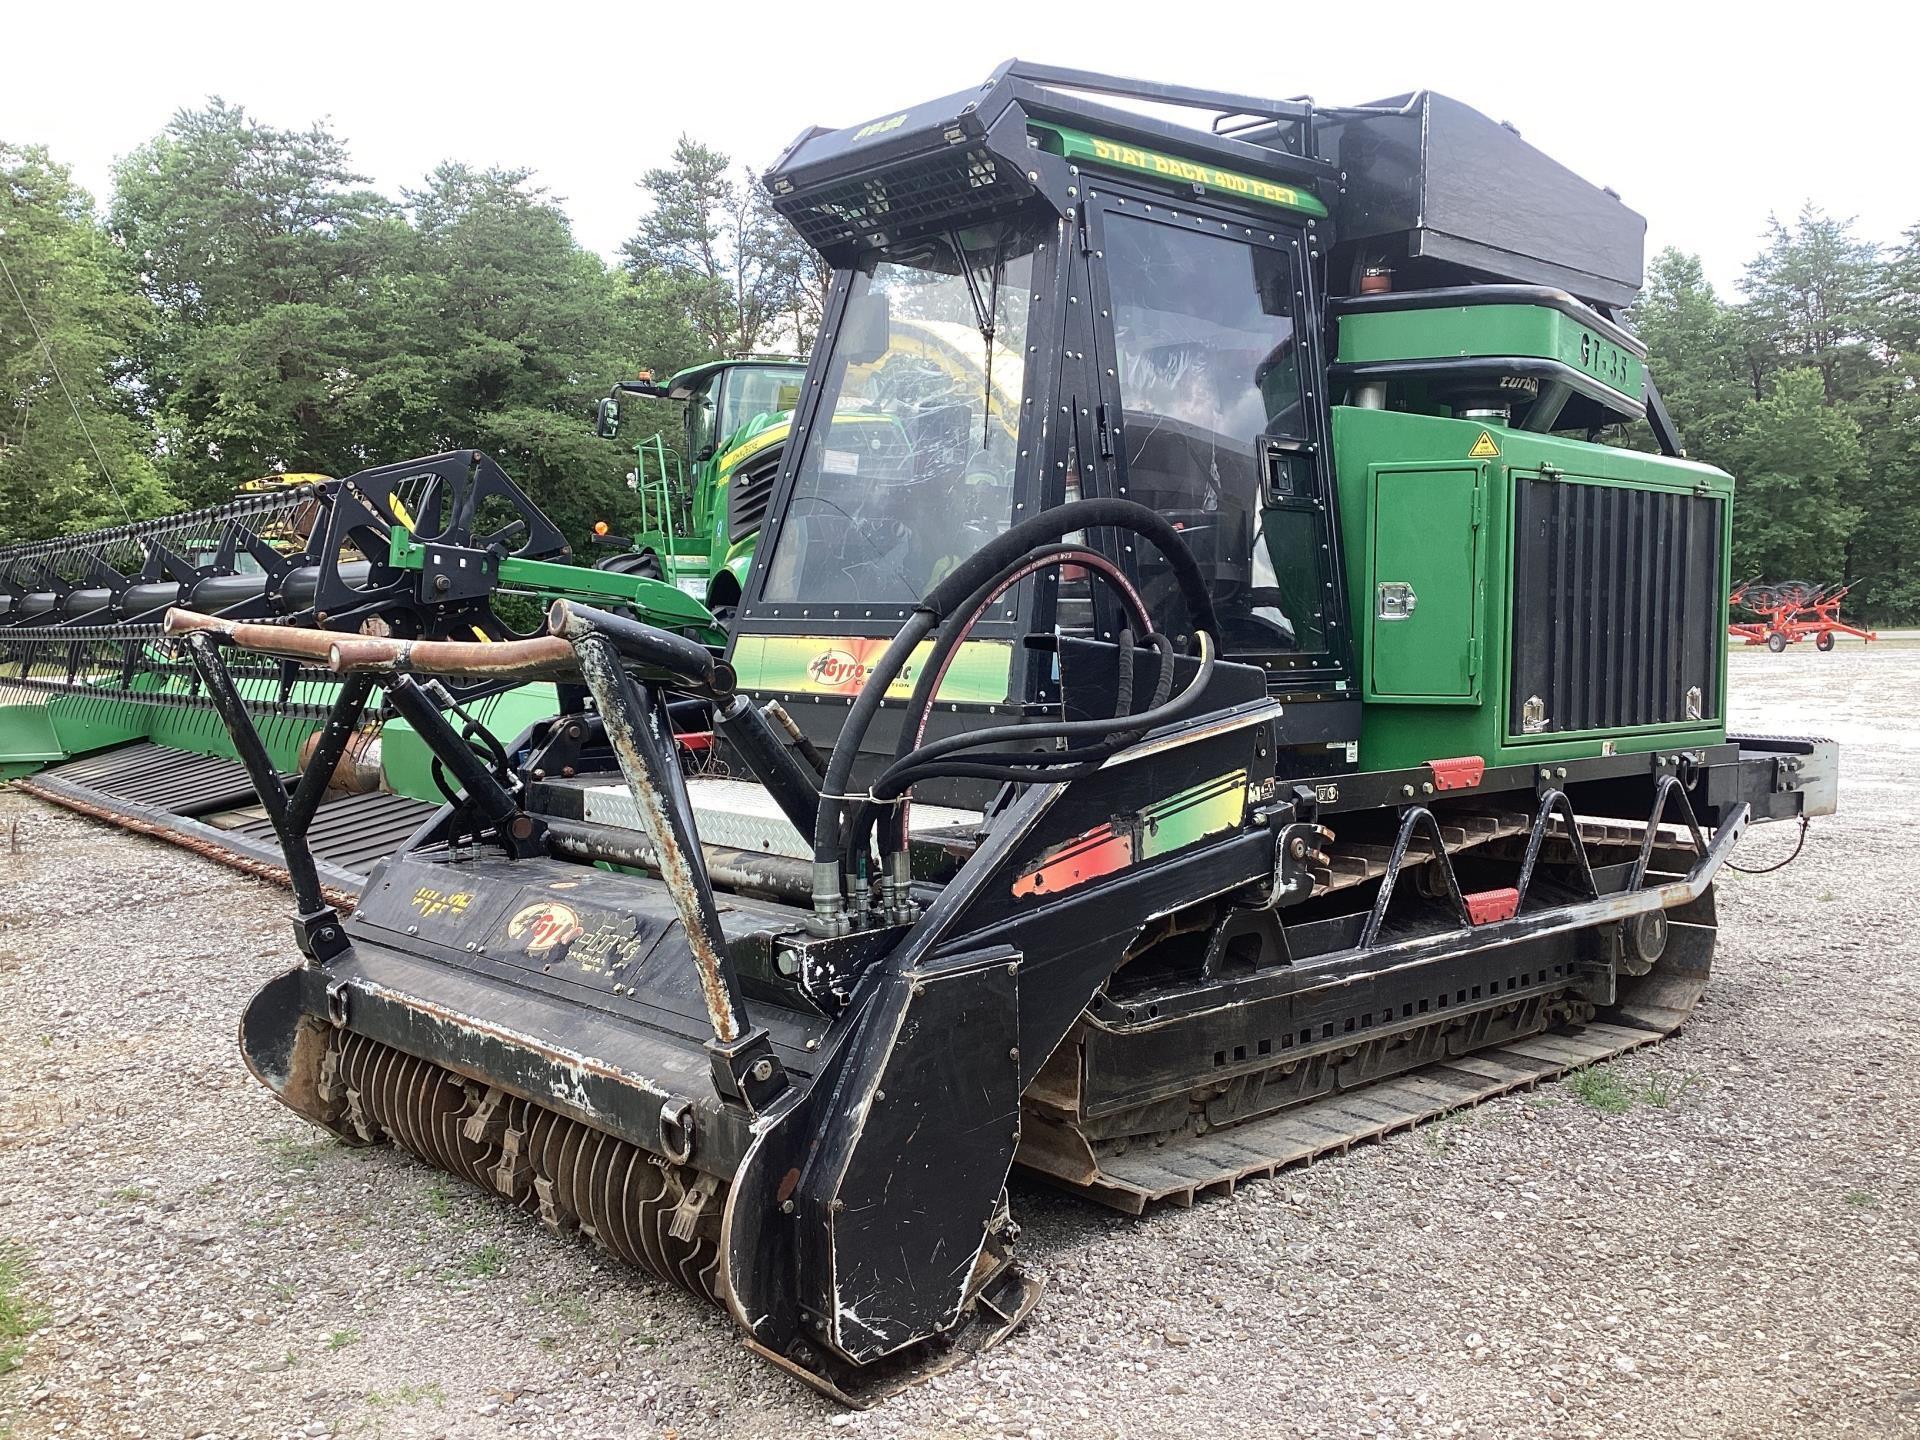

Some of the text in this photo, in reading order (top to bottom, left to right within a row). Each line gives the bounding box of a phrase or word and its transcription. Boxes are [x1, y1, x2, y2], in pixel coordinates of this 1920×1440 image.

[1091, 138, 1299, 206] STAY BACK 400 FEET
[1580, 333, 1627, 385] GT-35
